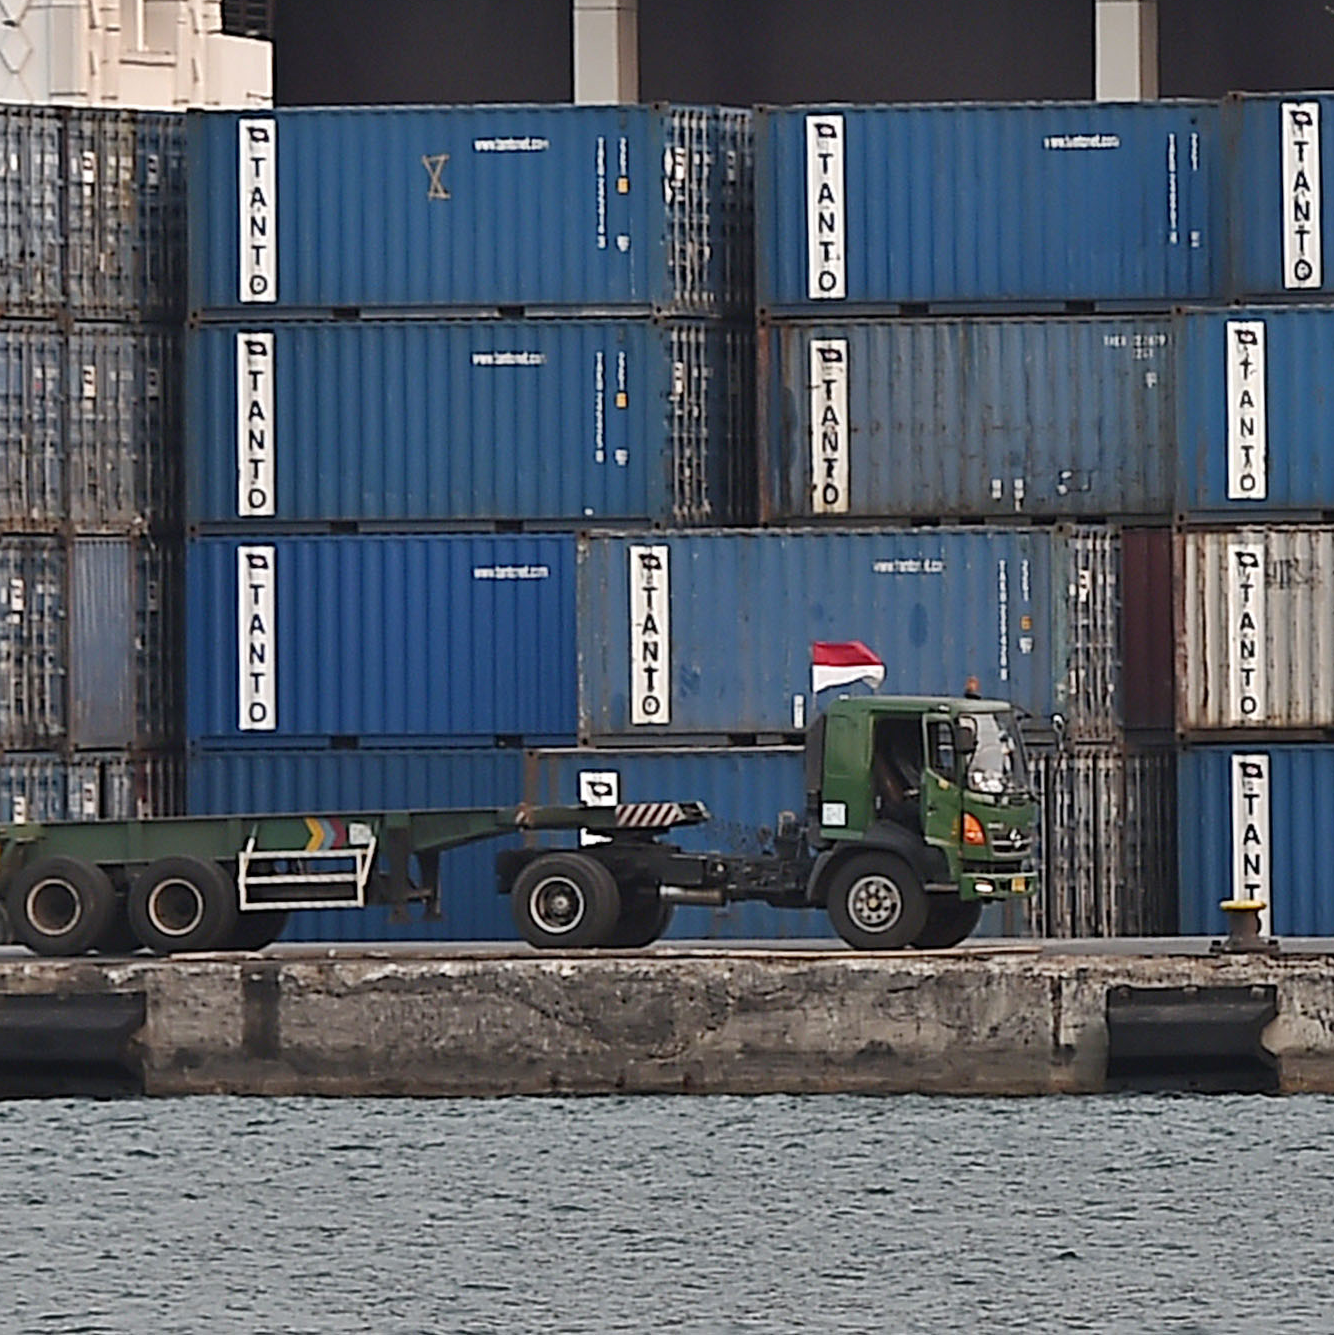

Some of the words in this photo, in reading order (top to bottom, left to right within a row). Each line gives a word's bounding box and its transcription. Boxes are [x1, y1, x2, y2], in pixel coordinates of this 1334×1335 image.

[249, 156, 268, 296] TANTO
[817, 152, 837, 293] TANTO
[1293, 140, 1313, 282] TANTO
[247, 369, 267, 509] TANTO
[821, 378, 840, 506] TANTO
[1239, 353, 1256, 492] TANTO
[248, 583, 267, 723] TANTO
[641, 586, 661, 716] TANTO
[1239, 582, 1257, 716] TANTO
